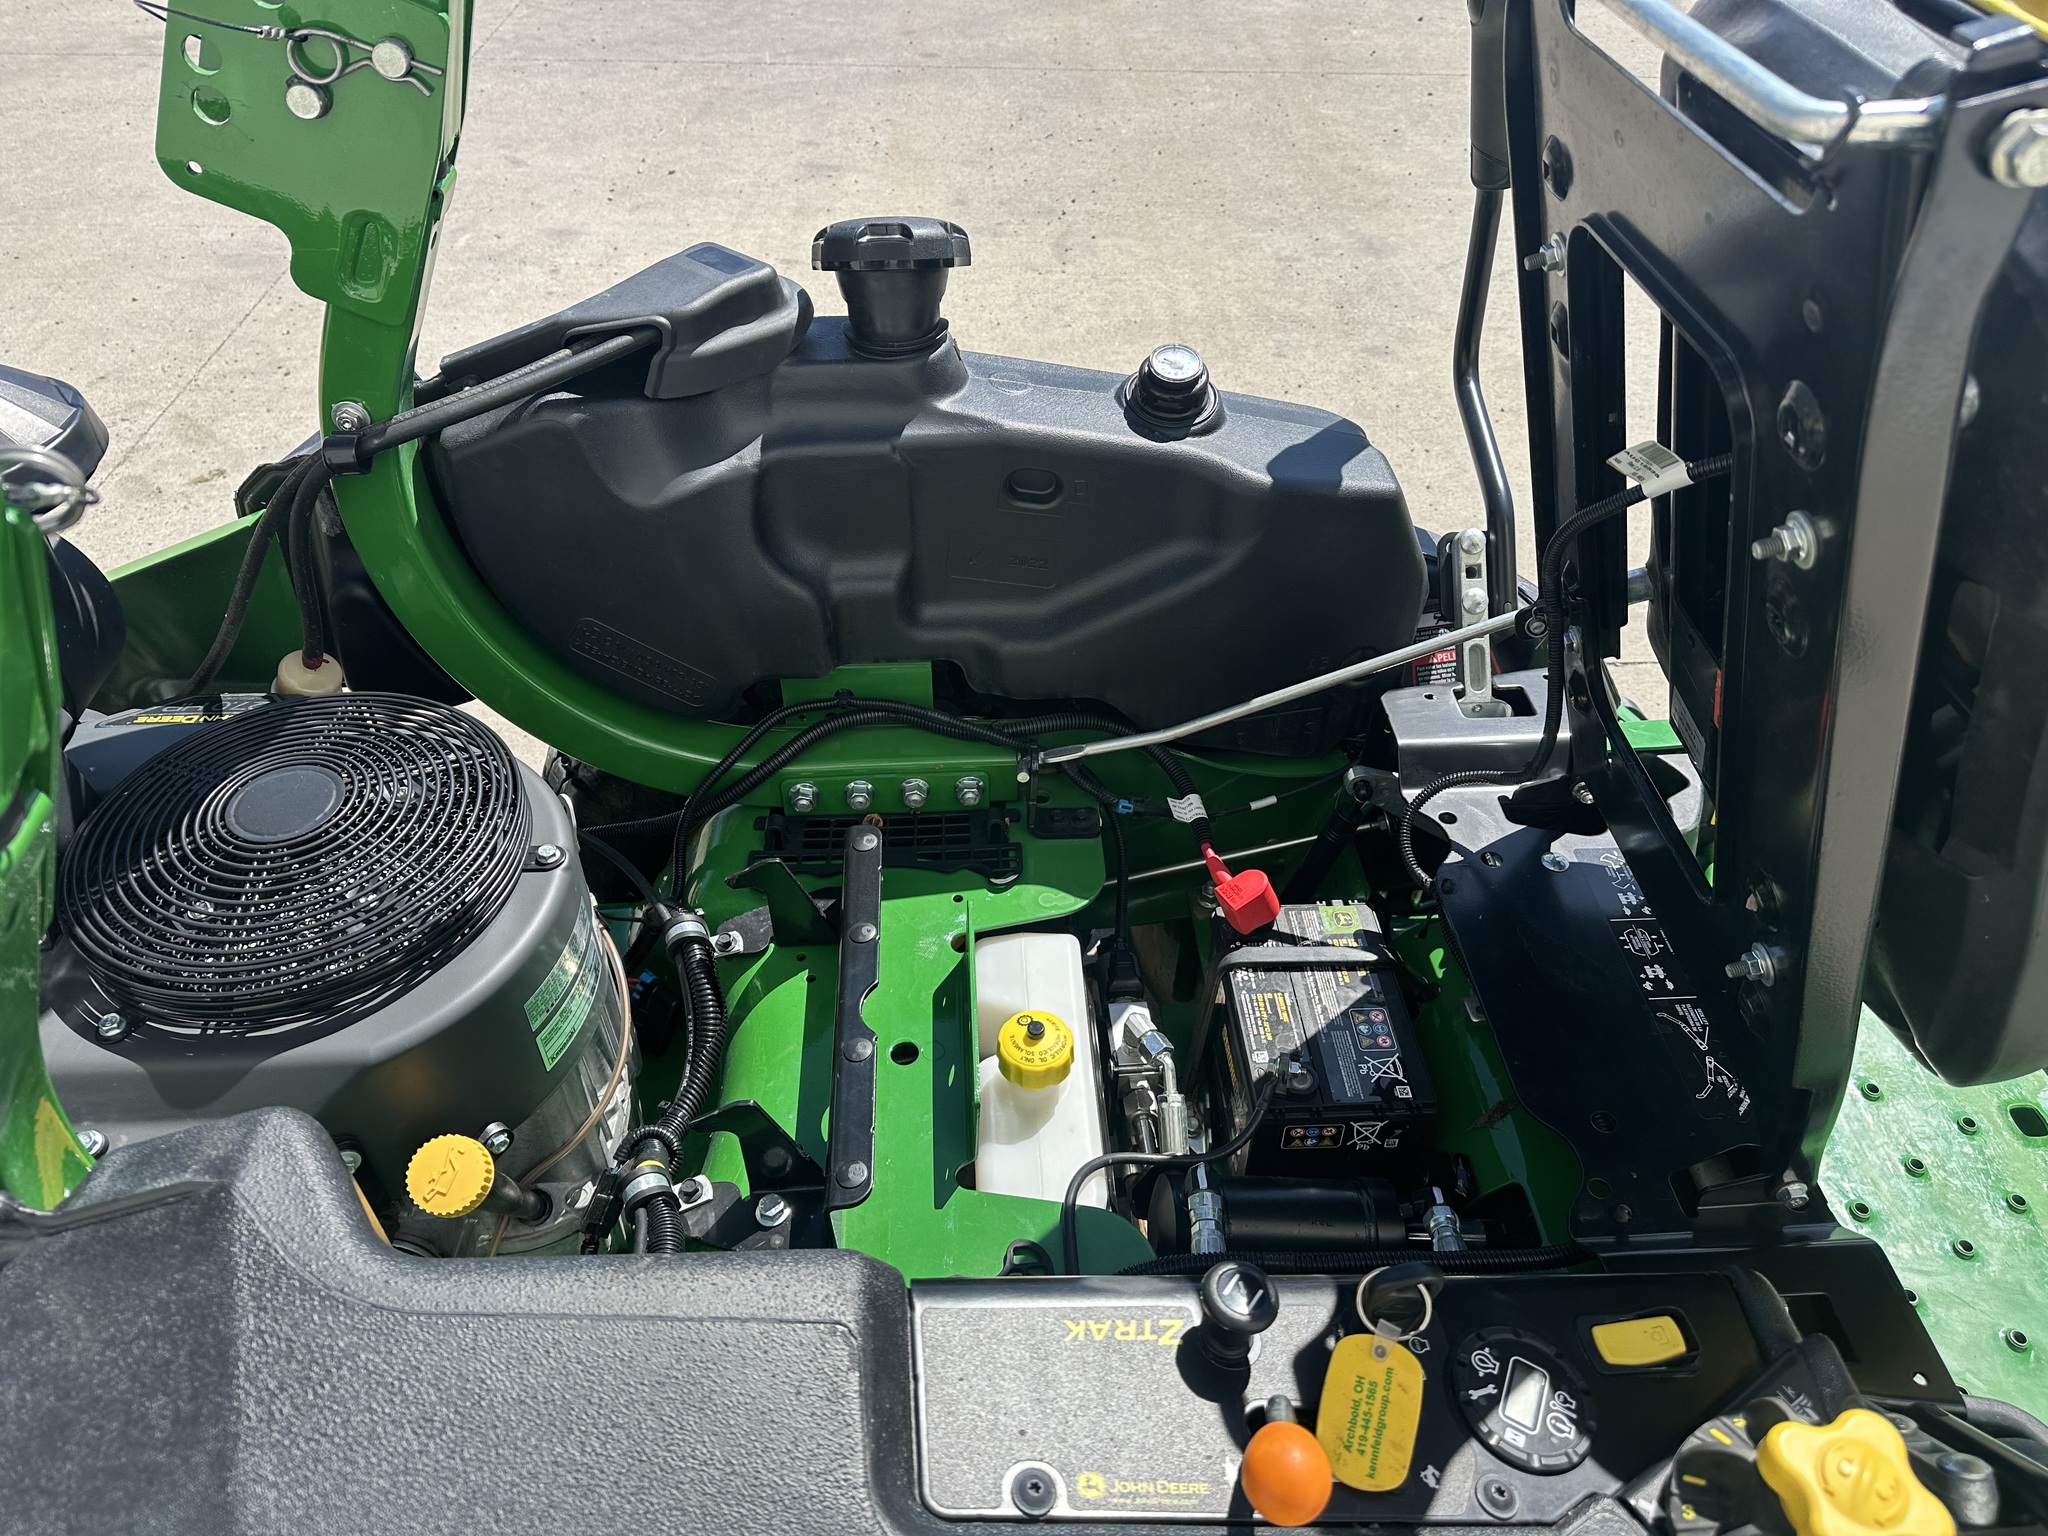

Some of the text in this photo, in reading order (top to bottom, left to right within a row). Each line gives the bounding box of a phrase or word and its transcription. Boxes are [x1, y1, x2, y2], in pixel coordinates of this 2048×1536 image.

[1437, 652, 1456, 663] PELI
[133, 714, 201, 724] DEERE
[1019, 1056, 1035, 1064] ONLY
[1358, 1063, 1369, 1075] Pb
[1356, 1143, 1370, 1151] Pb
[1064, 1318, 1184, 1346] ZTRAK
[1343, 1375, 1366, 1454] Archbold, OH
[1356, 1380, 1379, 1456] 419-445-1565
[1365, 1367, 1394, 1479] kennfeldgroup.com
[1110, 1479, 1211, 1495] JOHN DEERE
